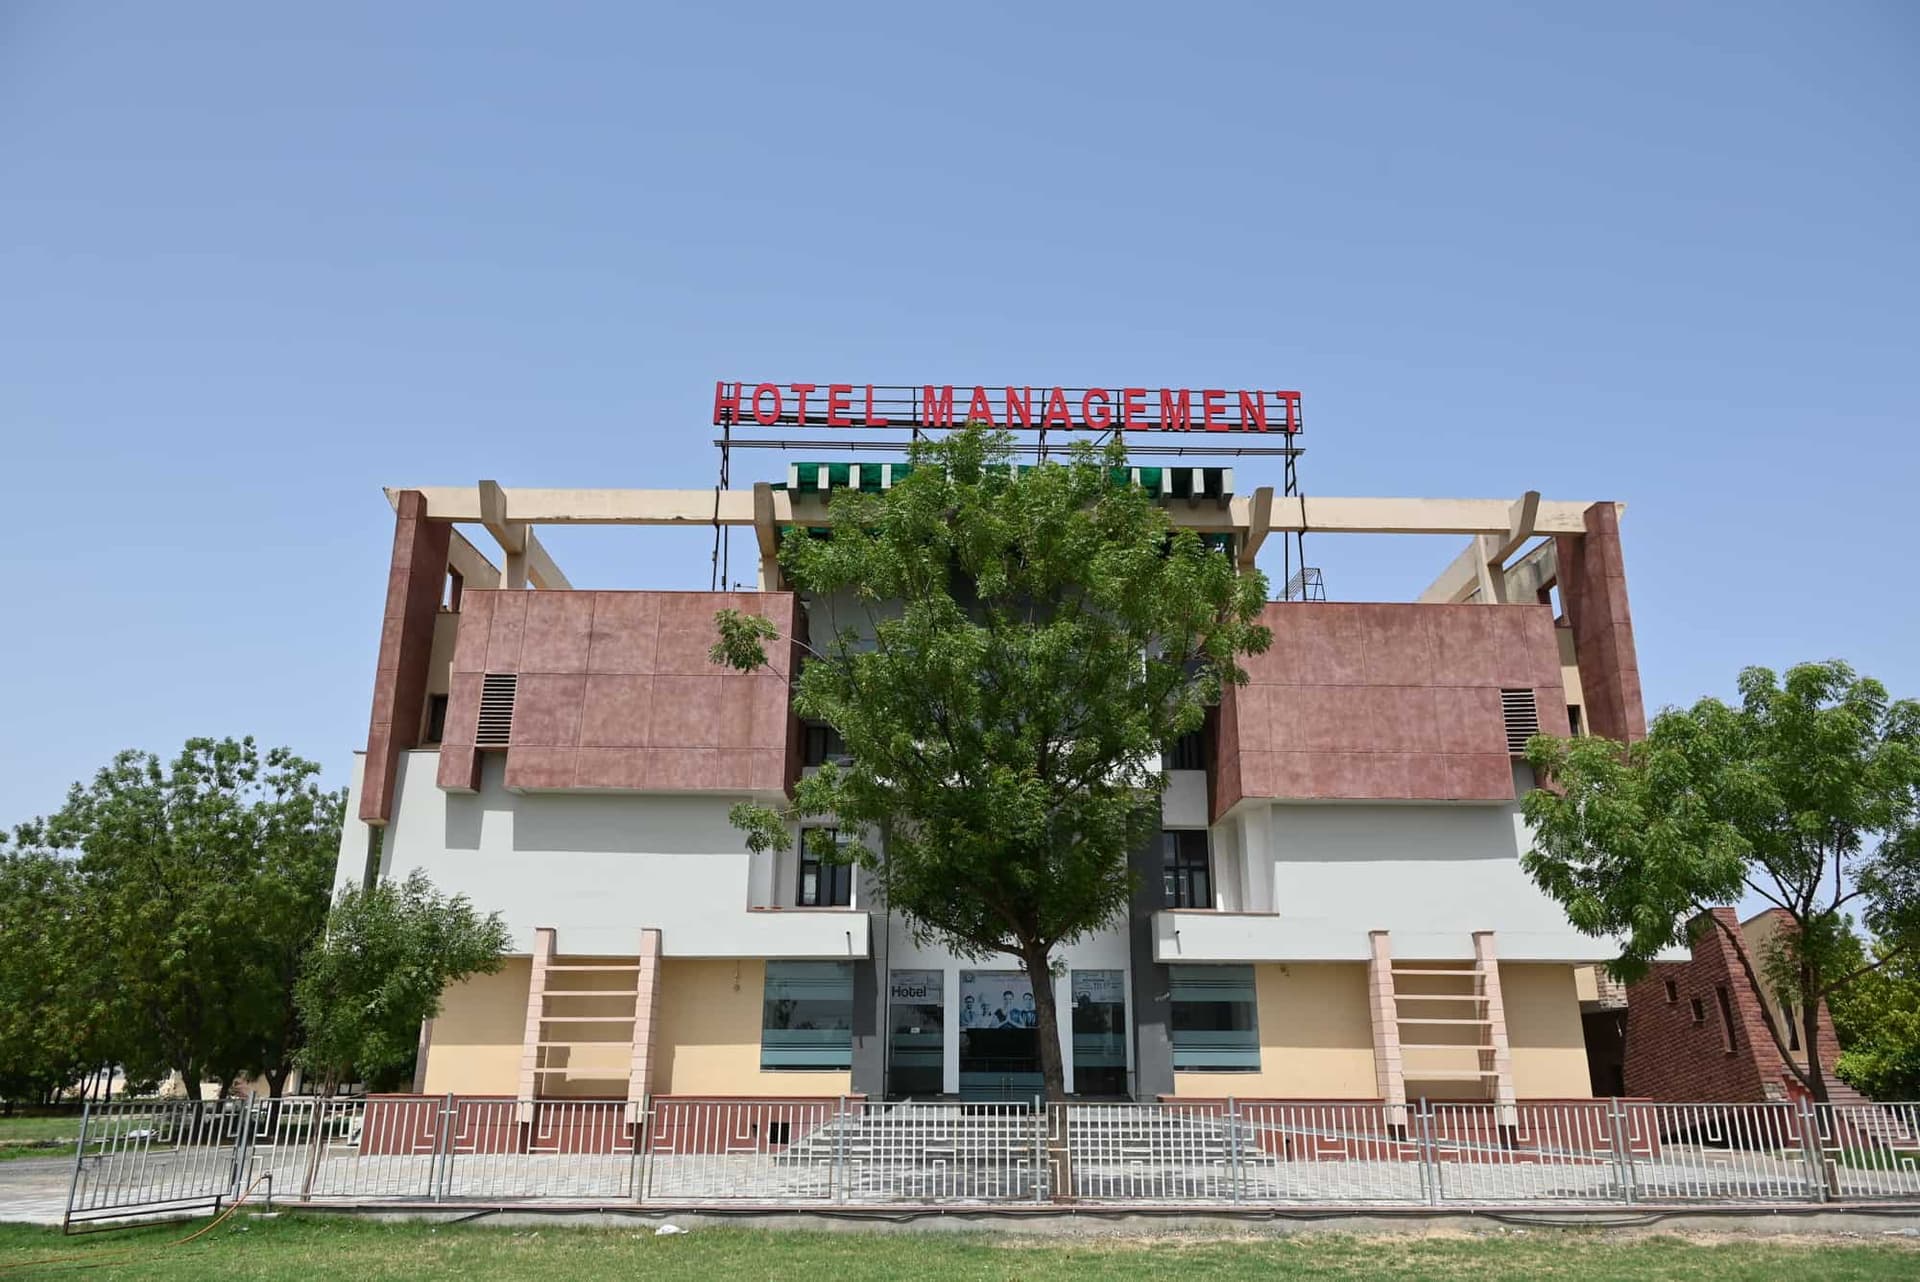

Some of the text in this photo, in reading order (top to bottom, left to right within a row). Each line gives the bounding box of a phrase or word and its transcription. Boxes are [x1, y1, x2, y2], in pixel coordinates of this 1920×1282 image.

[713, 382, 1301, 432] HOTEL MANAGEMENT
[891, 985, 927, 998] Hotel
